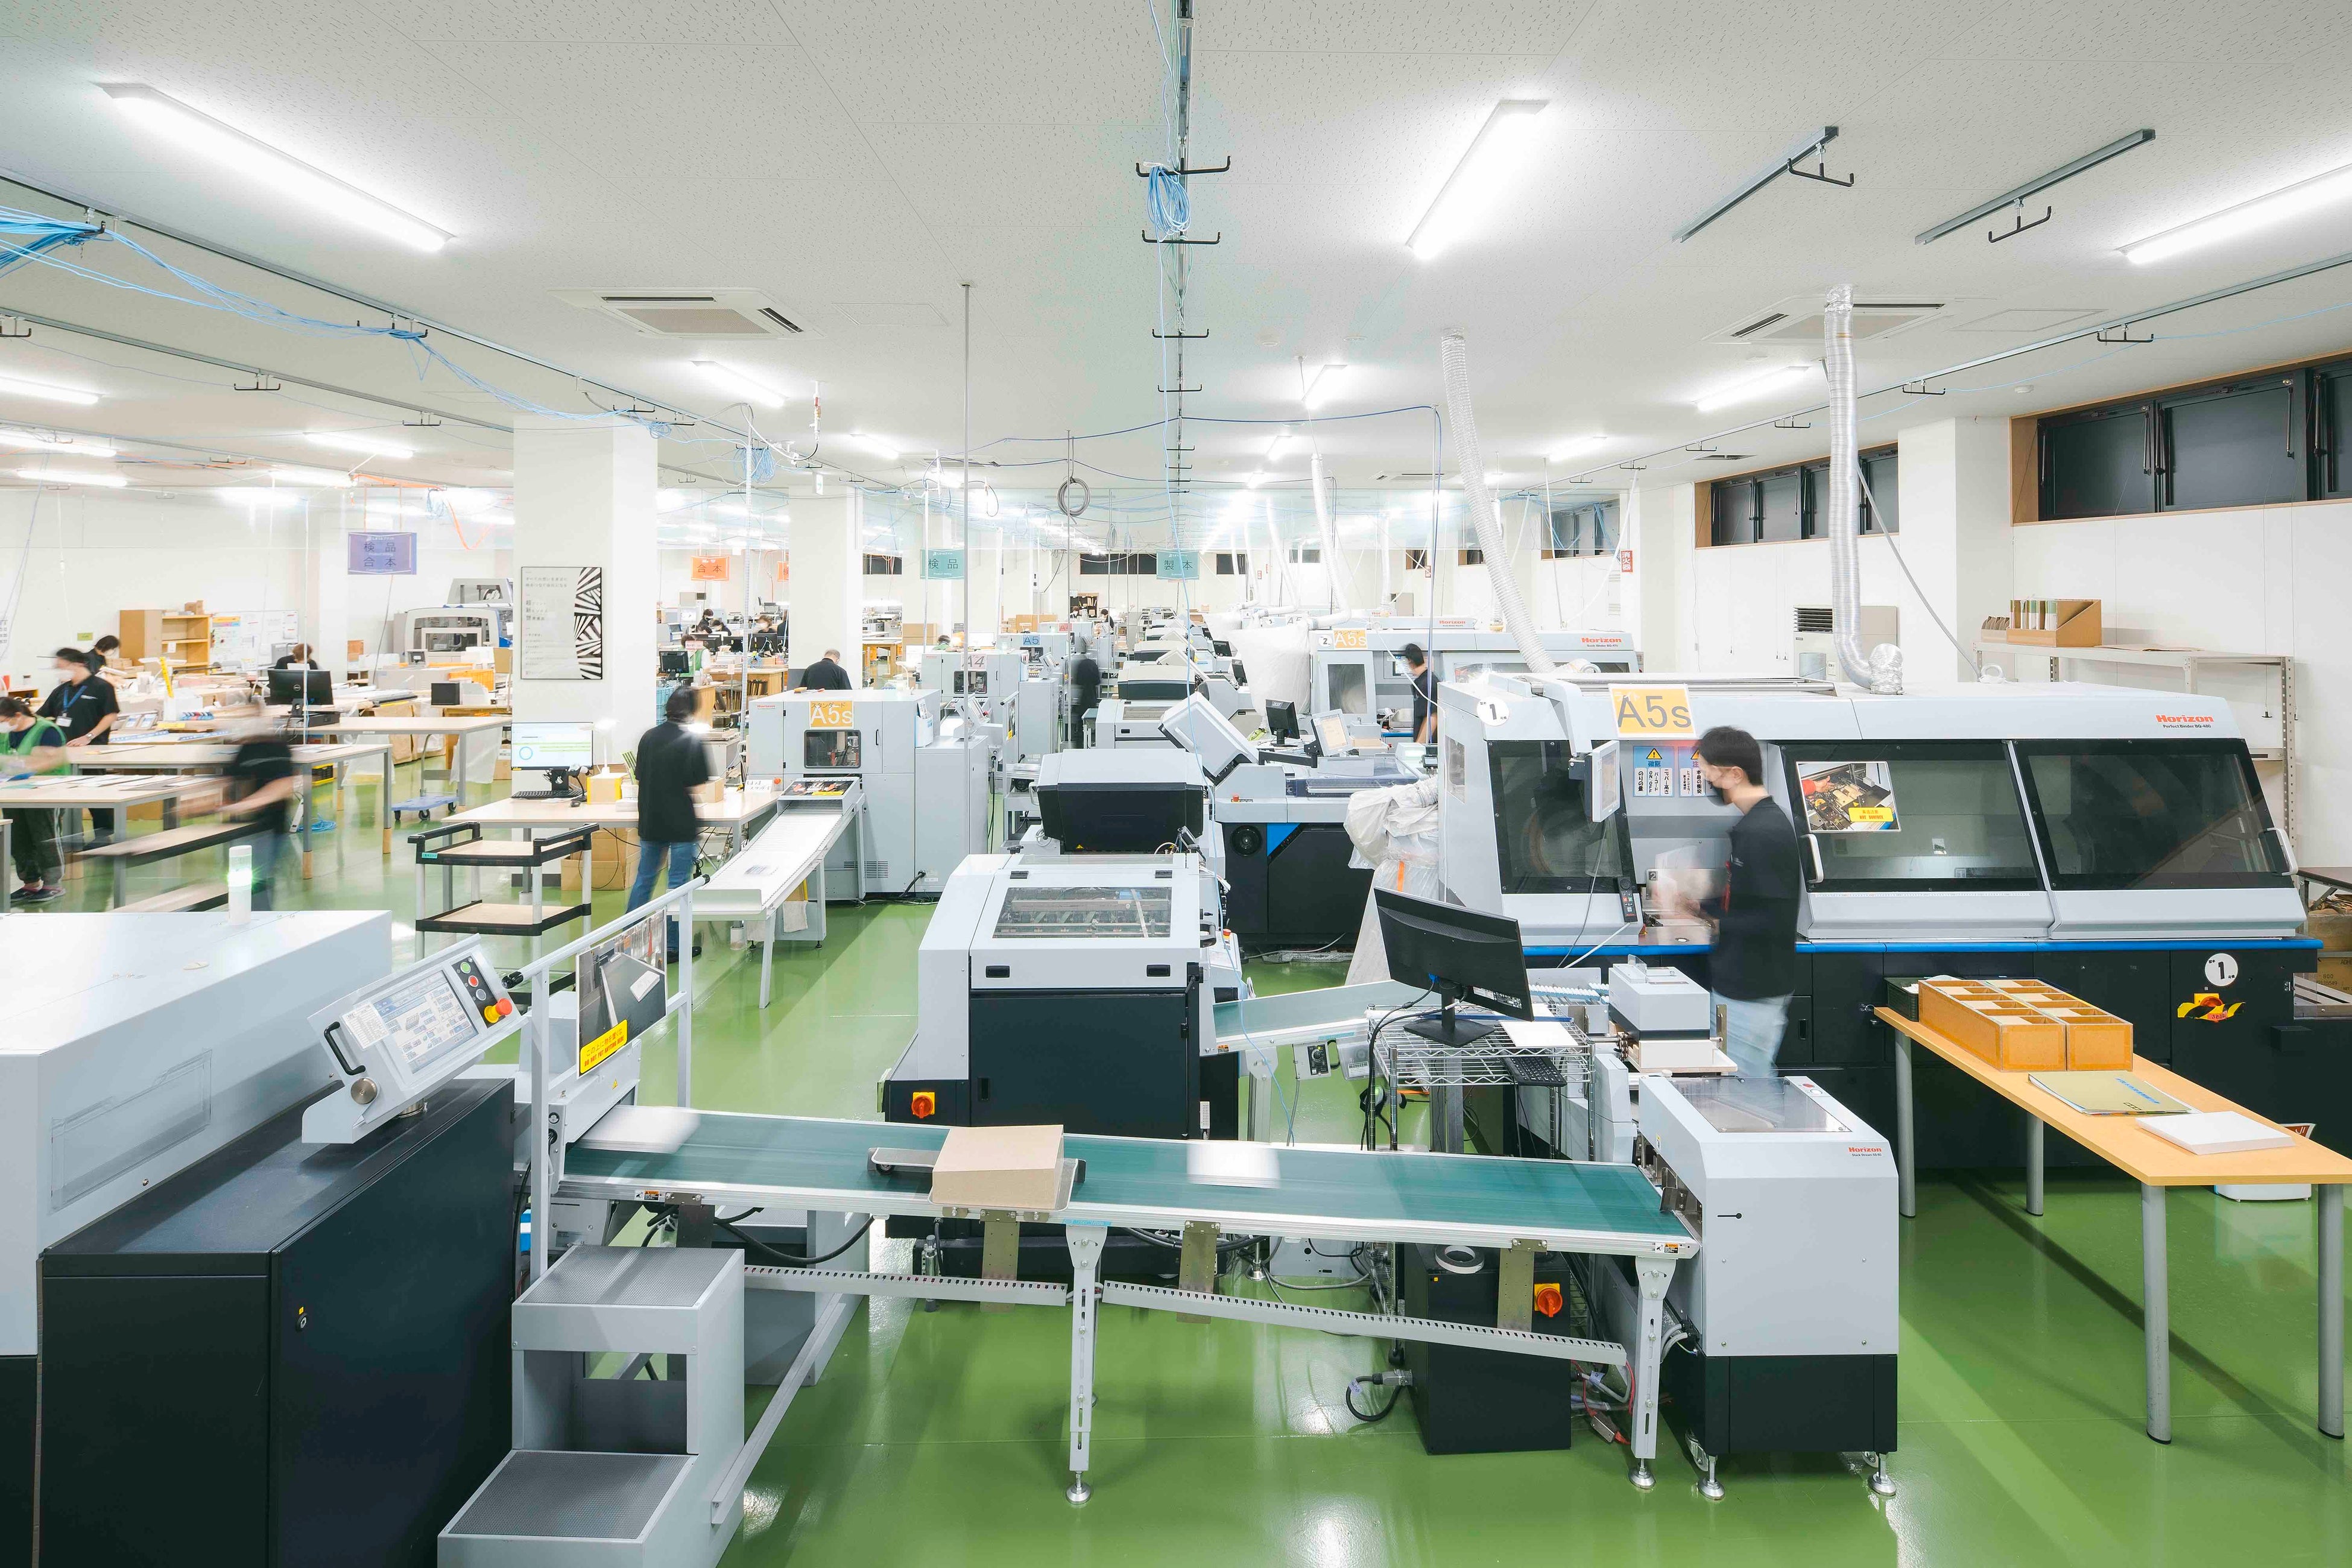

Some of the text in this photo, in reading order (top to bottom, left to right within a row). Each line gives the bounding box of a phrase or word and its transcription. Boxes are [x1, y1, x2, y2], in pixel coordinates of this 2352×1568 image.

[364, 542, 396, 552] 検品
[363, 557, 396, 567] 合本
[928, 558, 958, 569] 検品
[1164, 560, 1193, 570] 製本
[697, 564, 722, 573] 合本
[1023, 636, 1039, 645] A5
[1335, 633, 1367, 646] A5s
[961, 656, 985, 667] A4
[811, 705, 852, 724] A5s
[1490, 704, 1497, 720] 1
[1618, 695, 1692, 728] A5s
[1650, 872, 1657, 880] 2
[2218, 961, 2225, 980] 1
